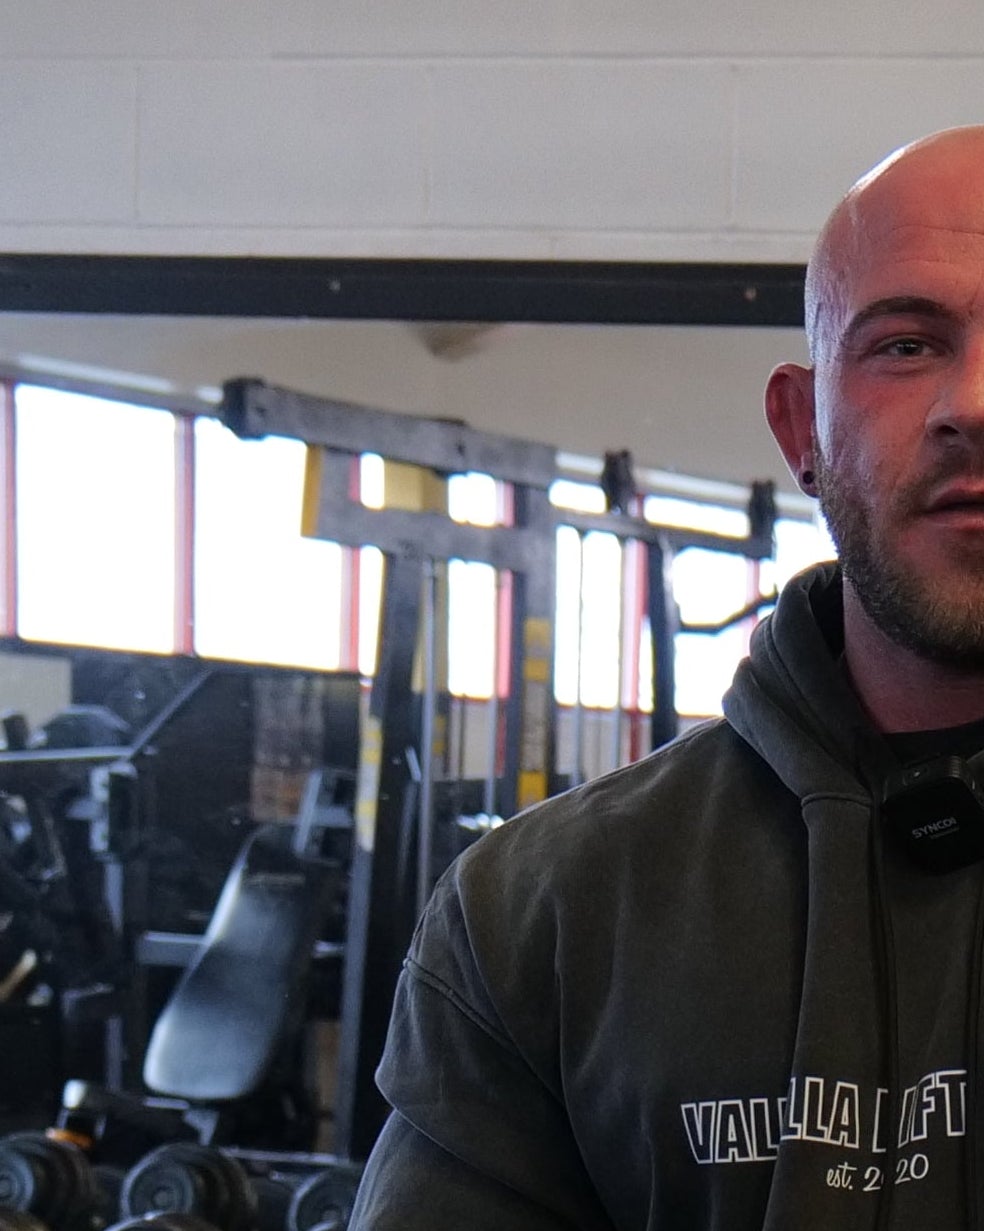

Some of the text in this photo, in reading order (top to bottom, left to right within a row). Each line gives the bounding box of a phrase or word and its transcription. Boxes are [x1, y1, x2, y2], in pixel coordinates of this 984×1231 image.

[681, 1077, 860, 1164] VALLLA
[826, 1153, 930, 1192] est. 220
